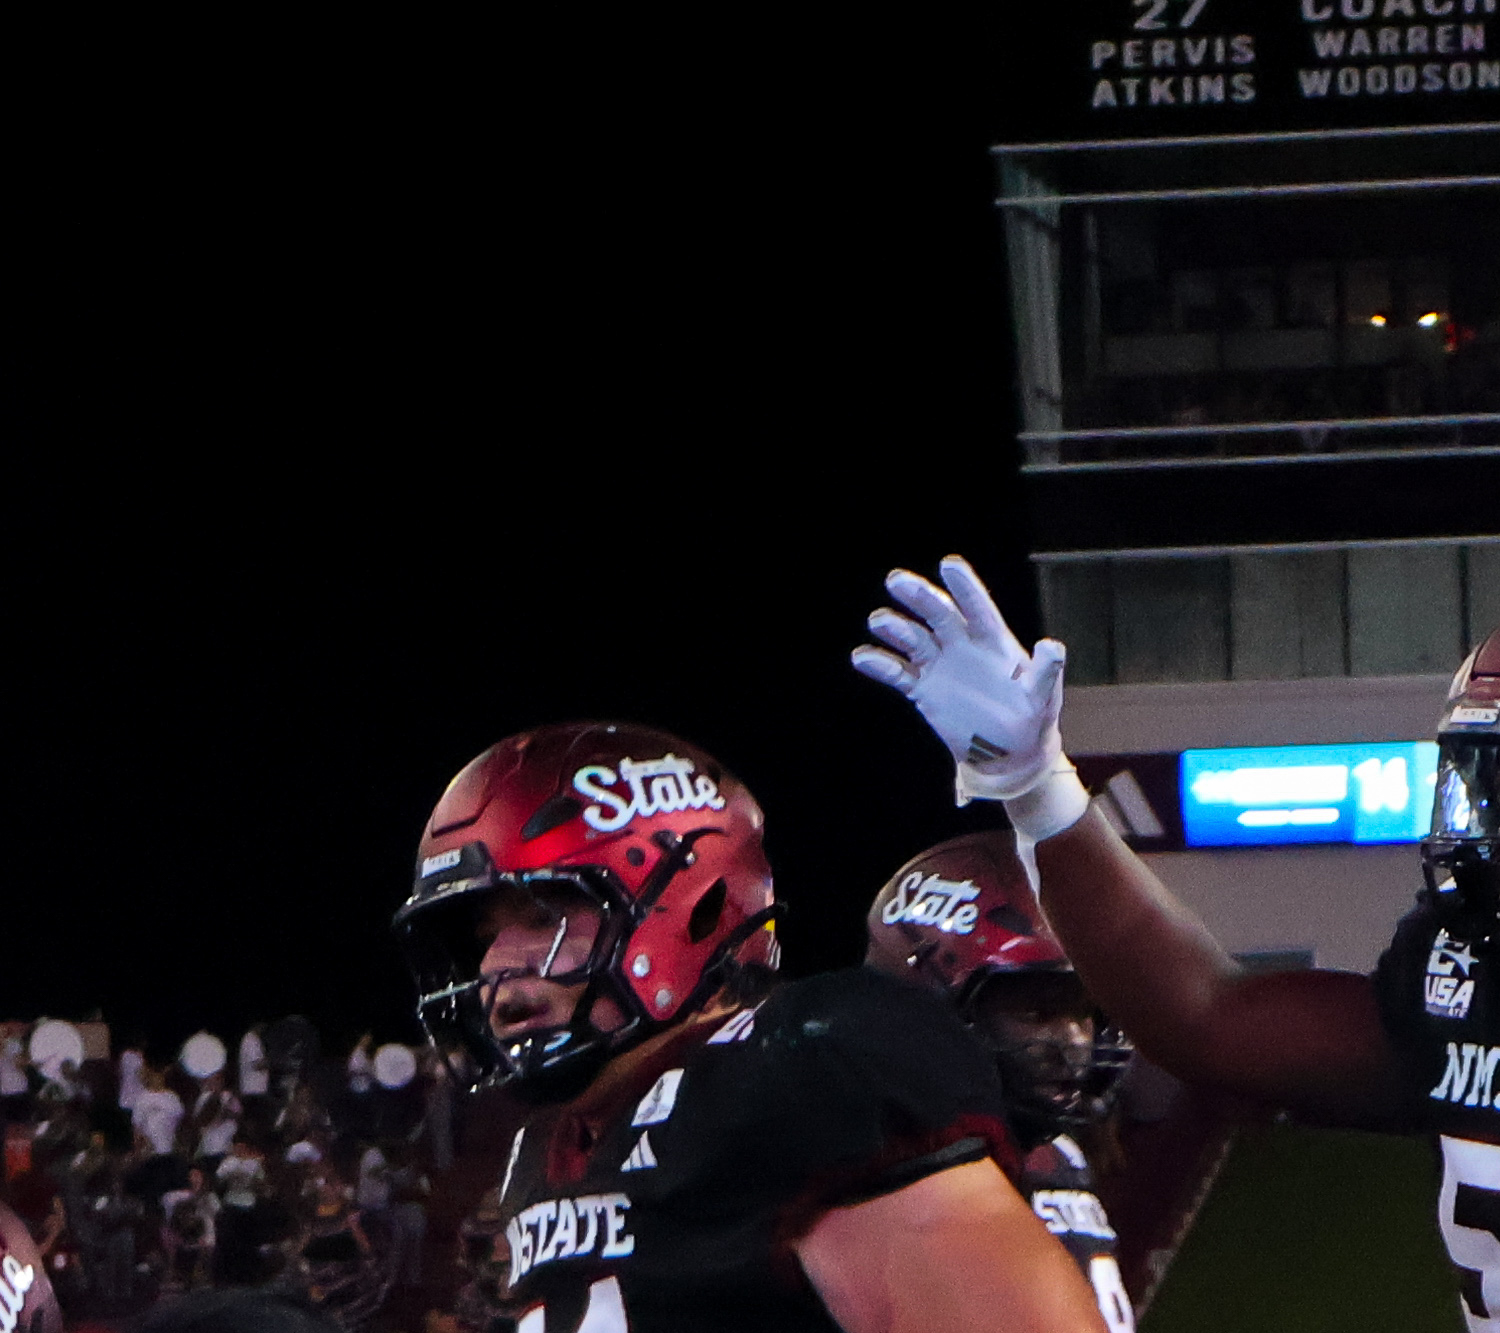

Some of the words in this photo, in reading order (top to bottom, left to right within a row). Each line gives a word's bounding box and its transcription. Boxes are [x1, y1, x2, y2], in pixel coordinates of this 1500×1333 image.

[1091, 34, 1256, 69] PERVIS
[1313, 24, 1486, 58] WARREN
[1092, 72, 1256, 108] ATKINS
[1300, 61, 1500, 97] WOODSON
[573, 753, 726, 832] State
[882, 872, 981, 935] State
[1425, 975, 1476, 1010] USA
